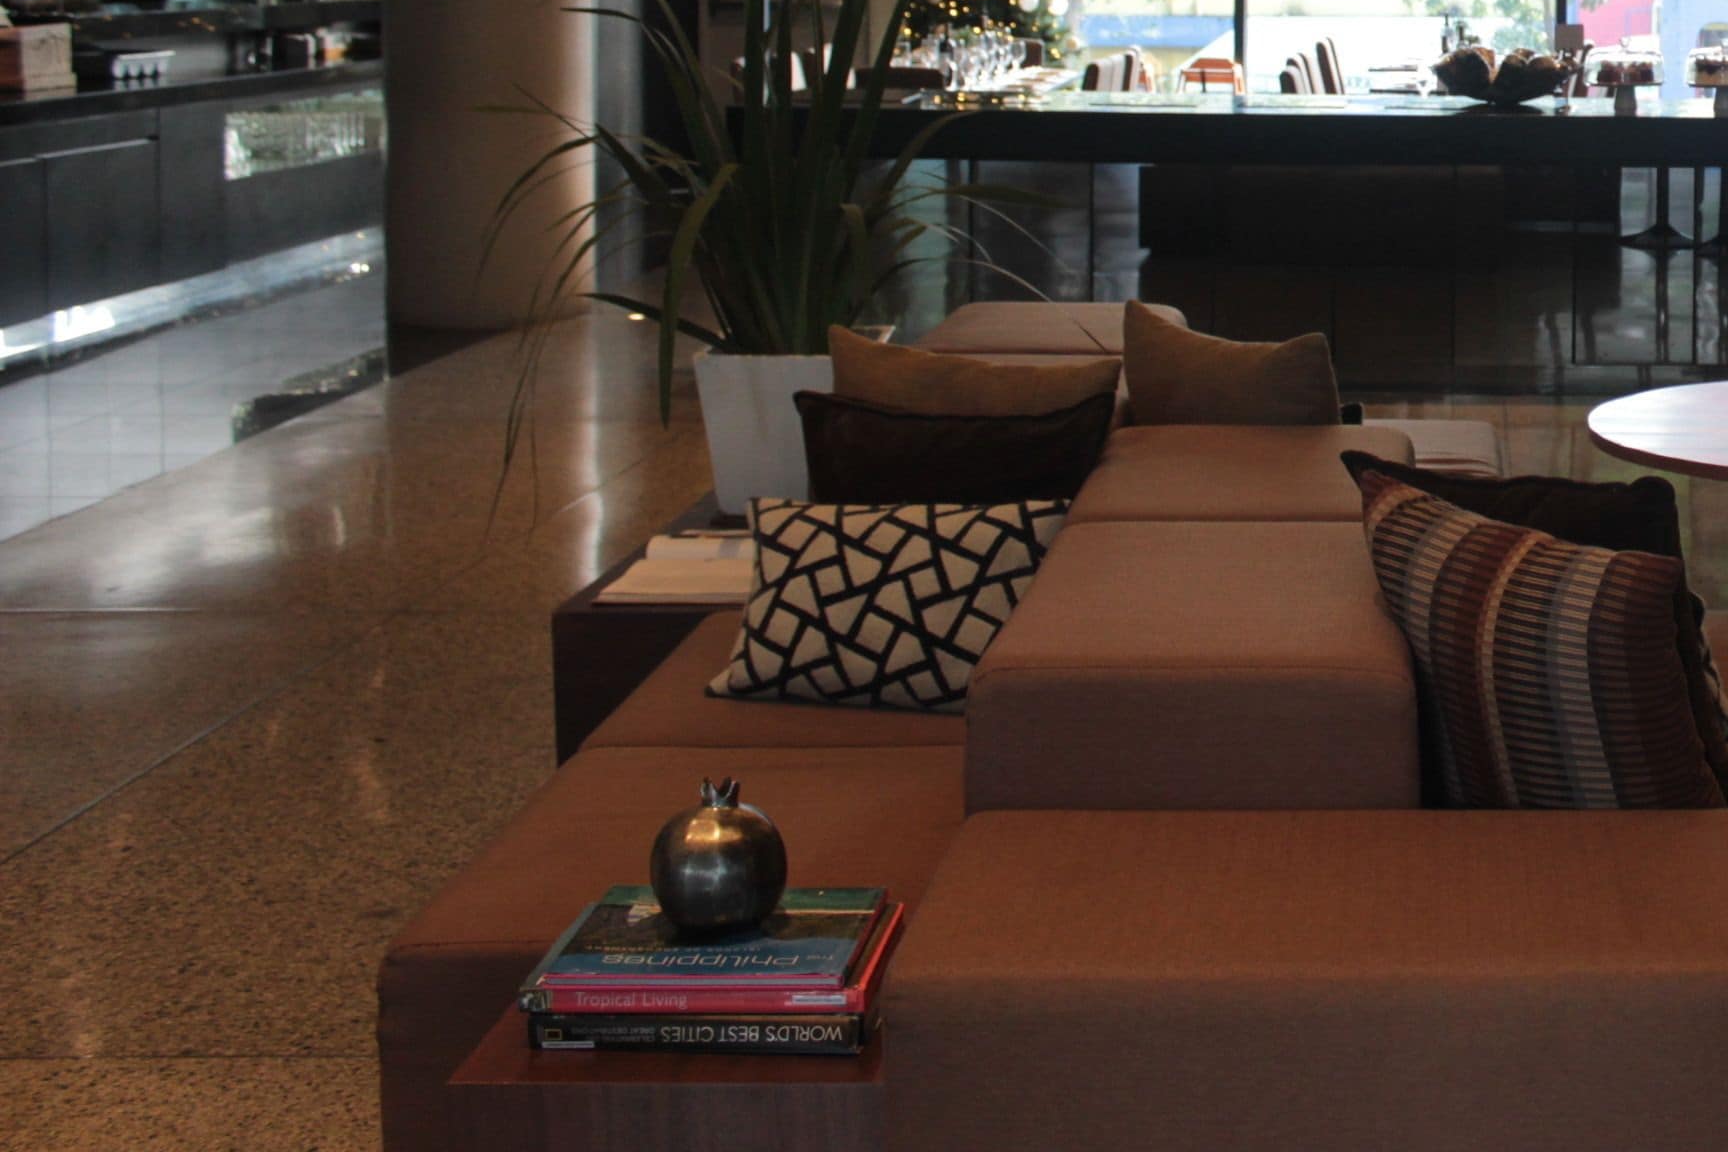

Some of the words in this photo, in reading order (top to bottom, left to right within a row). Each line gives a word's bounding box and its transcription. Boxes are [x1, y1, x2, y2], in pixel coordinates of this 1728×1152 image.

[576, 991, 635, 1008] Tropical
[642, 991, 688, 1010] Living
[660, 1026, 714, 1043] CITIES
[718, 1026, 759, 1042] BEST
[766, 1025, 843, 1042] WORLD'S
